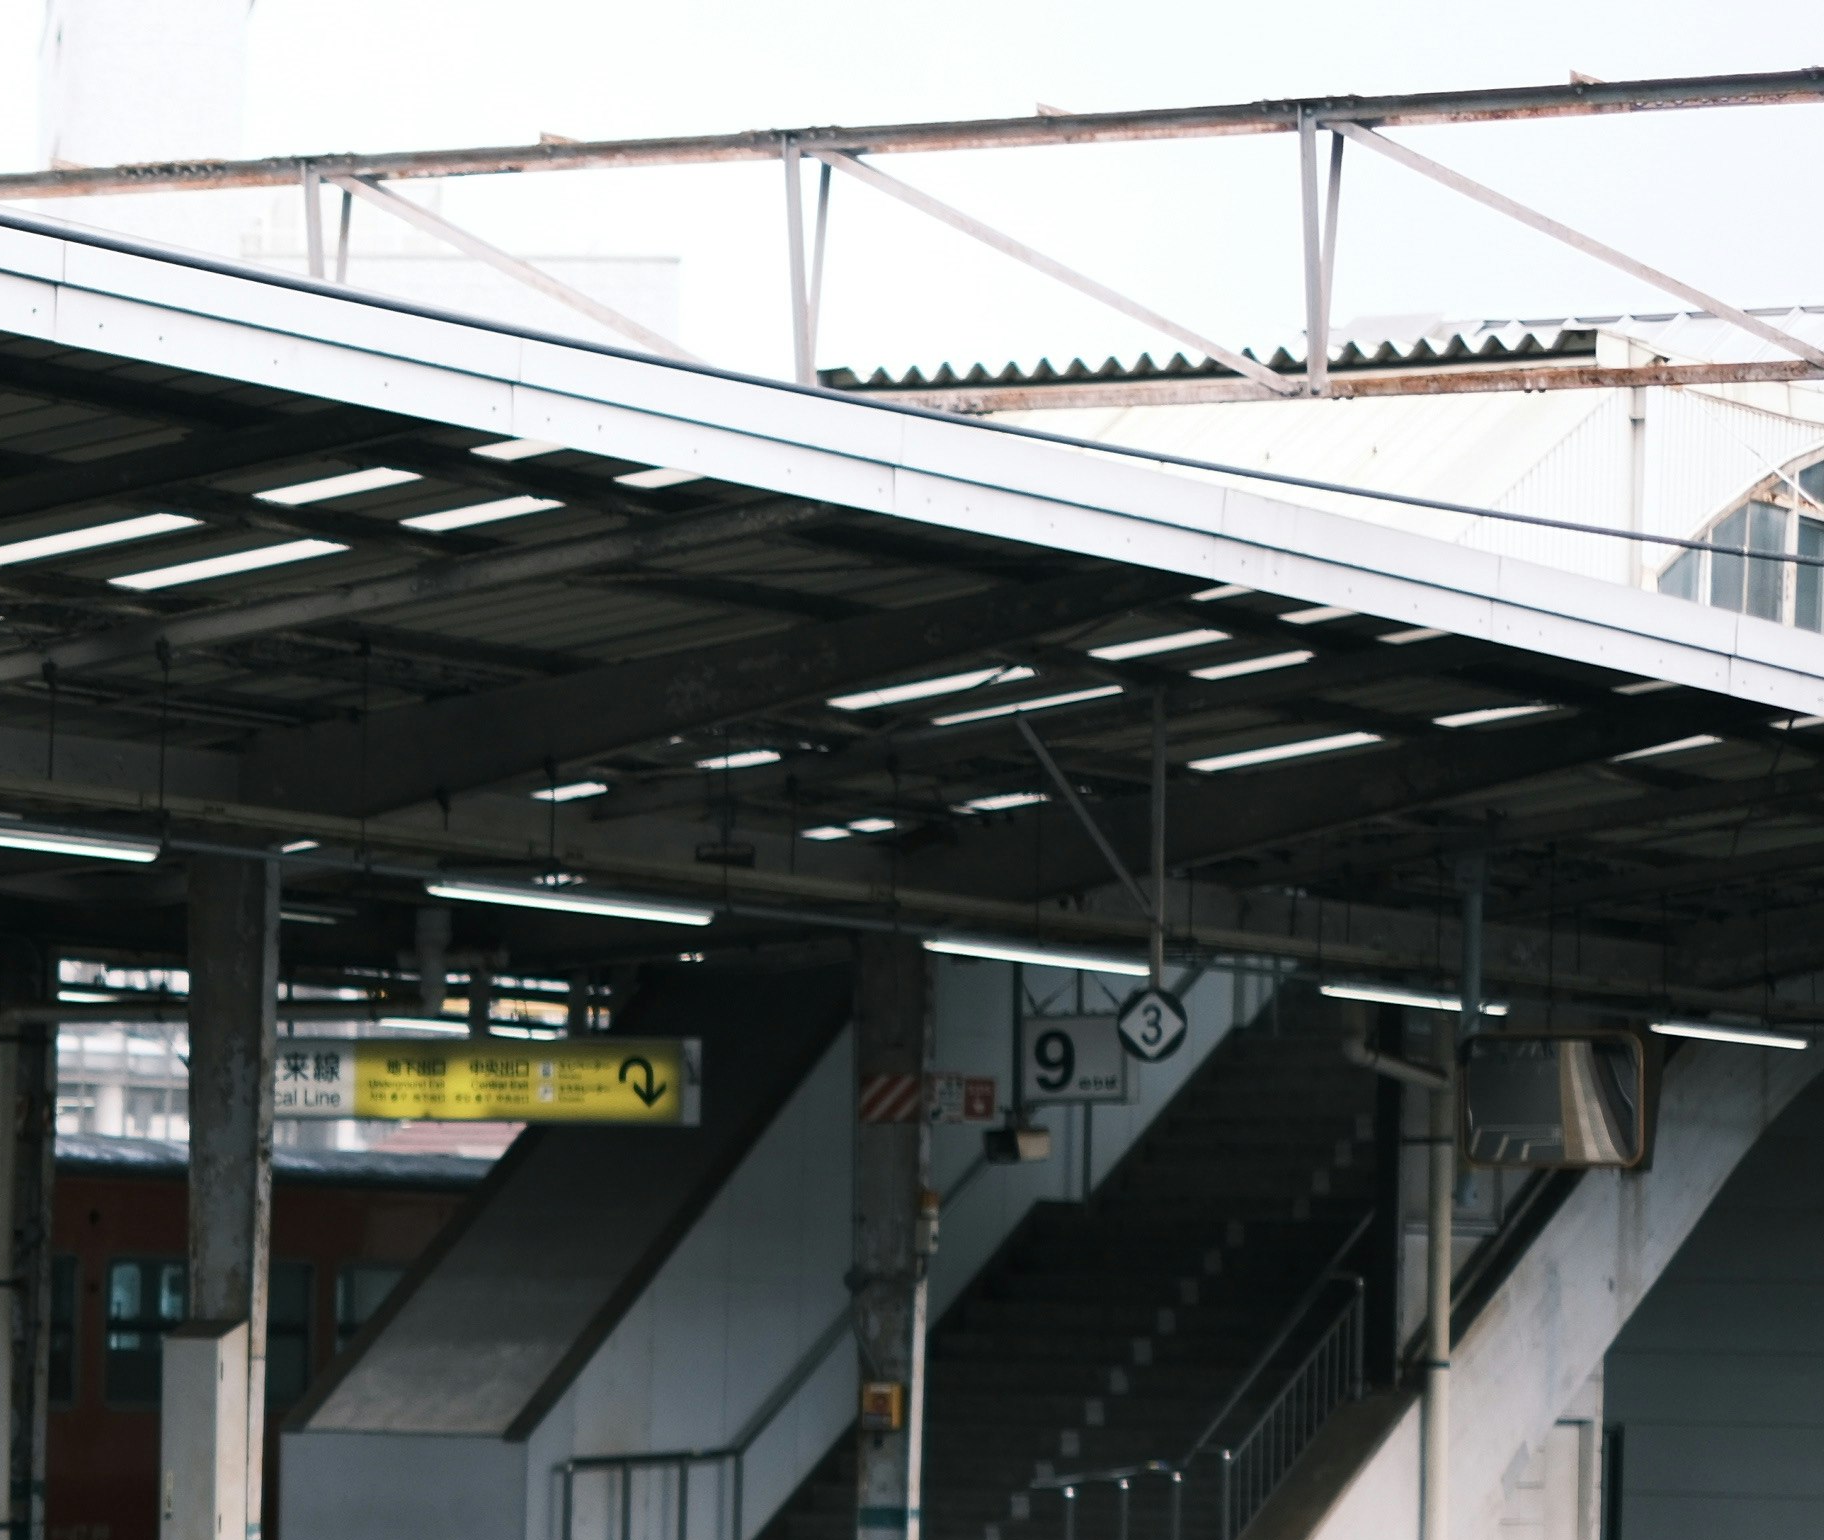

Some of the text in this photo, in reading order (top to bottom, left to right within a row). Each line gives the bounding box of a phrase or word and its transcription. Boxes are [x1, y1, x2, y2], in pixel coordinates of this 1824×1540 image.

[1141, 1003, 1163, 1047] 3
[274, 1053, 340, 1083] 来線
[1034, 1029, 1075, 1092] 9
[304, 1089, 341, 1107] Line
